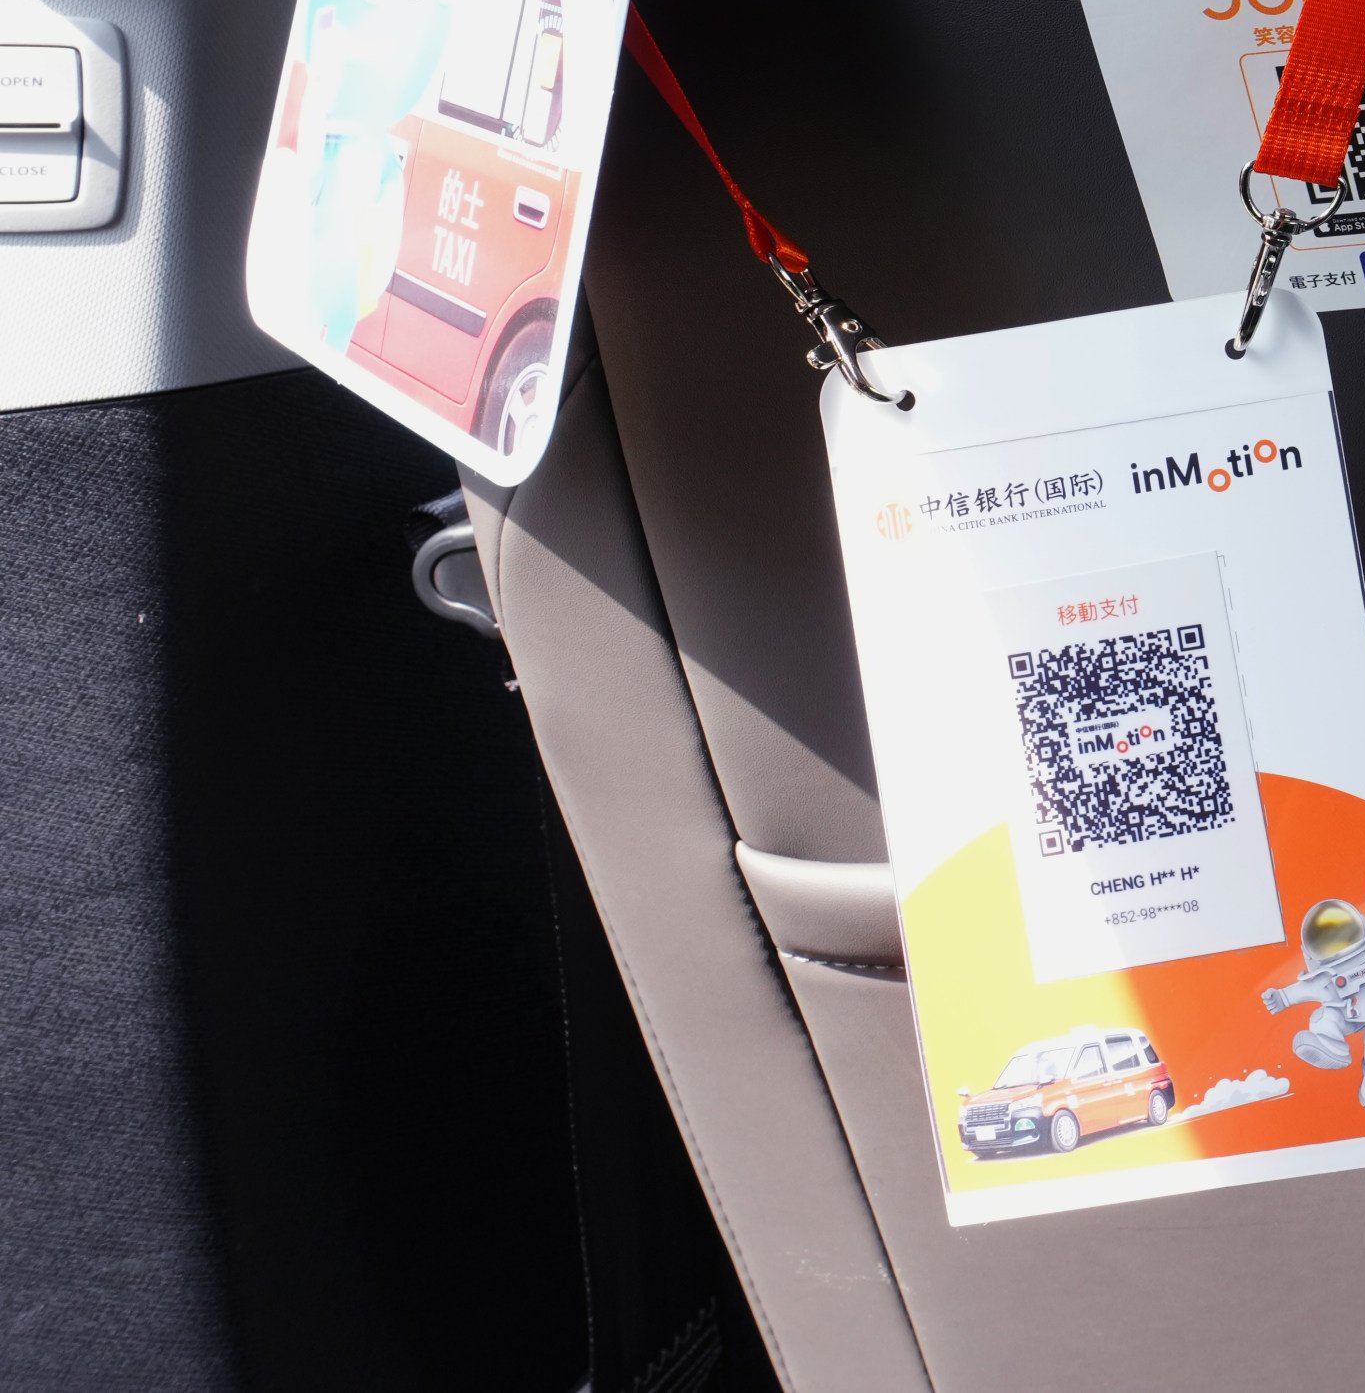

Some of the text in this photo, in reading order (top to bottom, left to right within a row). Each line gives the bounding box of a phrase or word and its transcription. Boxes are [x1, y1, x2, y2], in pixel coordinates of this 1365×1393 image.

[1253, 25, 1295, 46] 笑容
[0, 77, 43, 86] OPEN
[0, 166, 47, 176] CLOSE
[437, 167, 484, 231] 的士
[1334, 223, 1353, 232] App
[433, 226, 477, 286] TAXI
[1289, 270, 1357, 291] 電子支付
[1131, 439, 1303, 494] inMotion
[919, 469, 1104, 520] 中信银行(国际)
[958, 519, 986, 531] CITIC
[989, 514, 1018, 526] BANK
[1022, 500, 1107, 520] INTERNATIONAL
[1057, 594, 1140, 625] 移動支付
[1077, 725, 1166, 755] inMotion
[1090, 875, 1145, 896] CHENG
